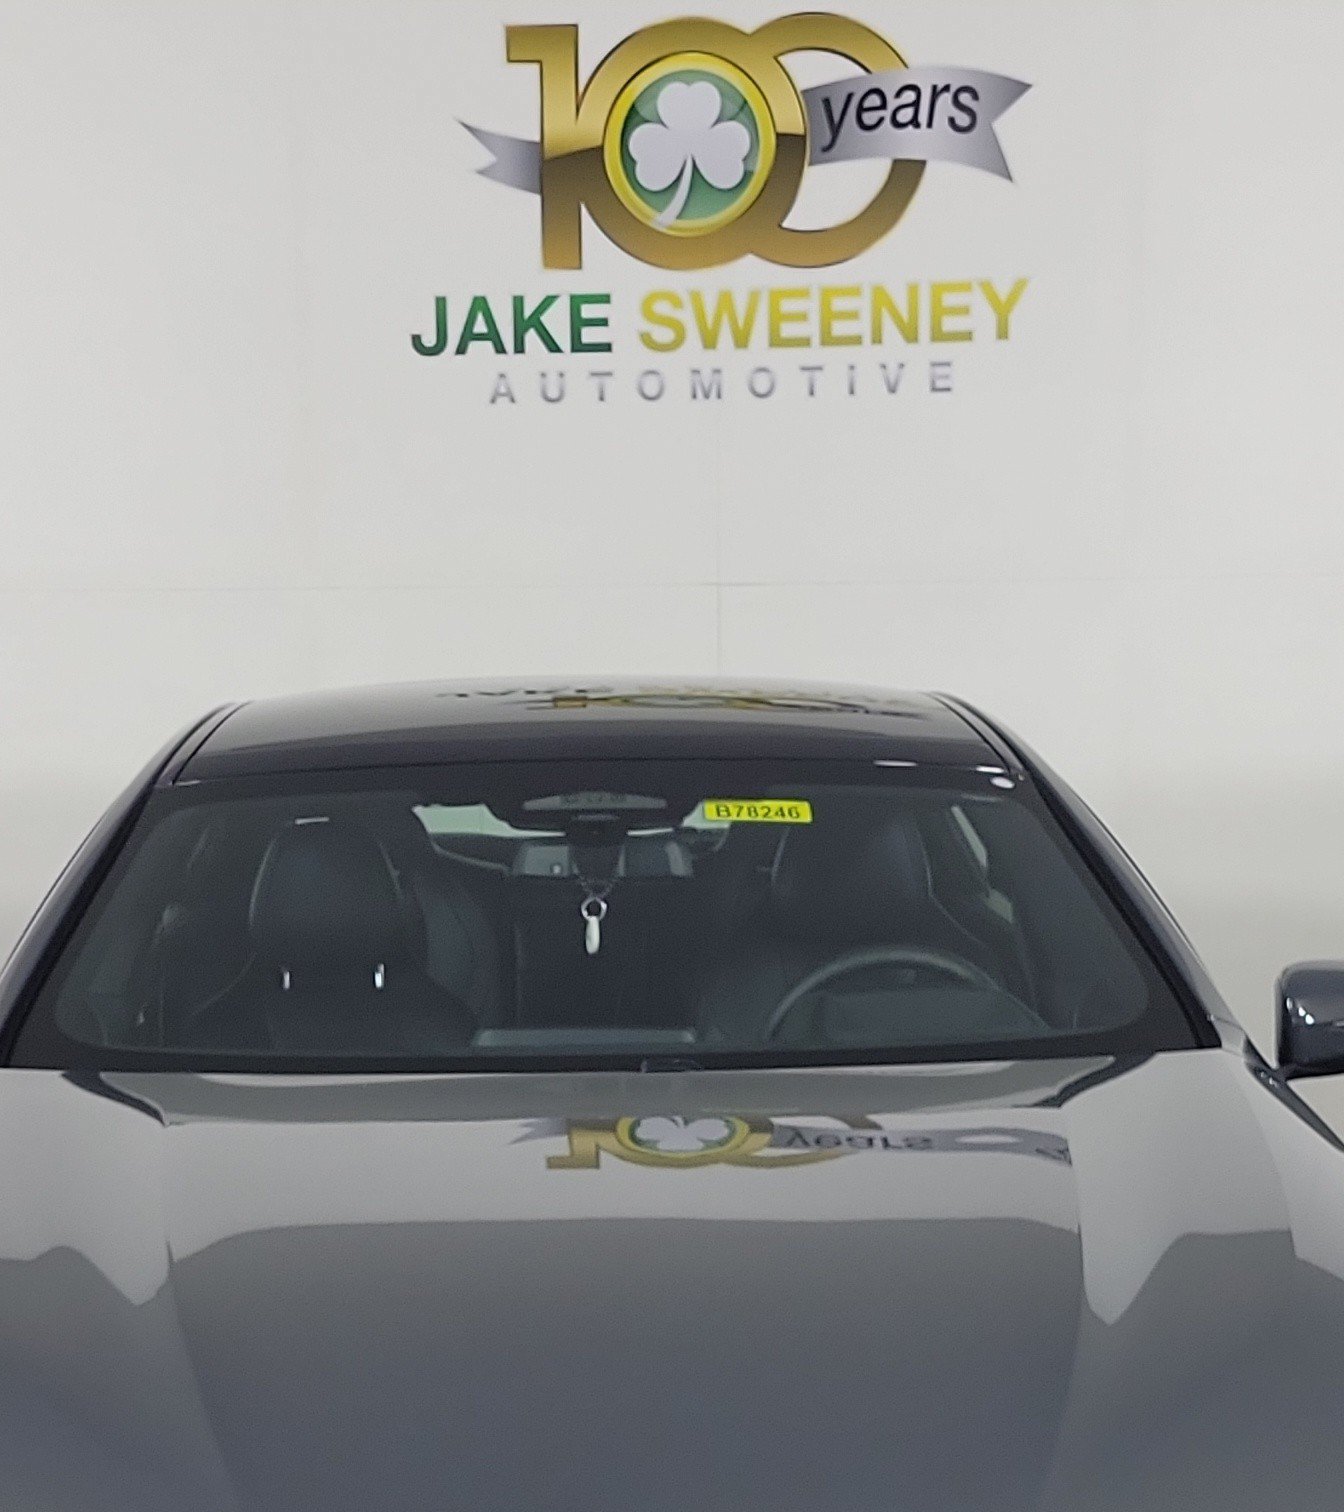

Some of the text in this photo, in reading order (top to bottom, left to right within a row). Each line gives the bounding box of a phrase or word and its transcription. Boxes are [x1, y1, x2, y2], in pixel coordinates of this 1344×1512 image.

[820, 82, 980, 152] years
[410, 277, 1030, 357] JAKE SWEENEY
[489, 360, 955, 406] AUTOMOTIVE
